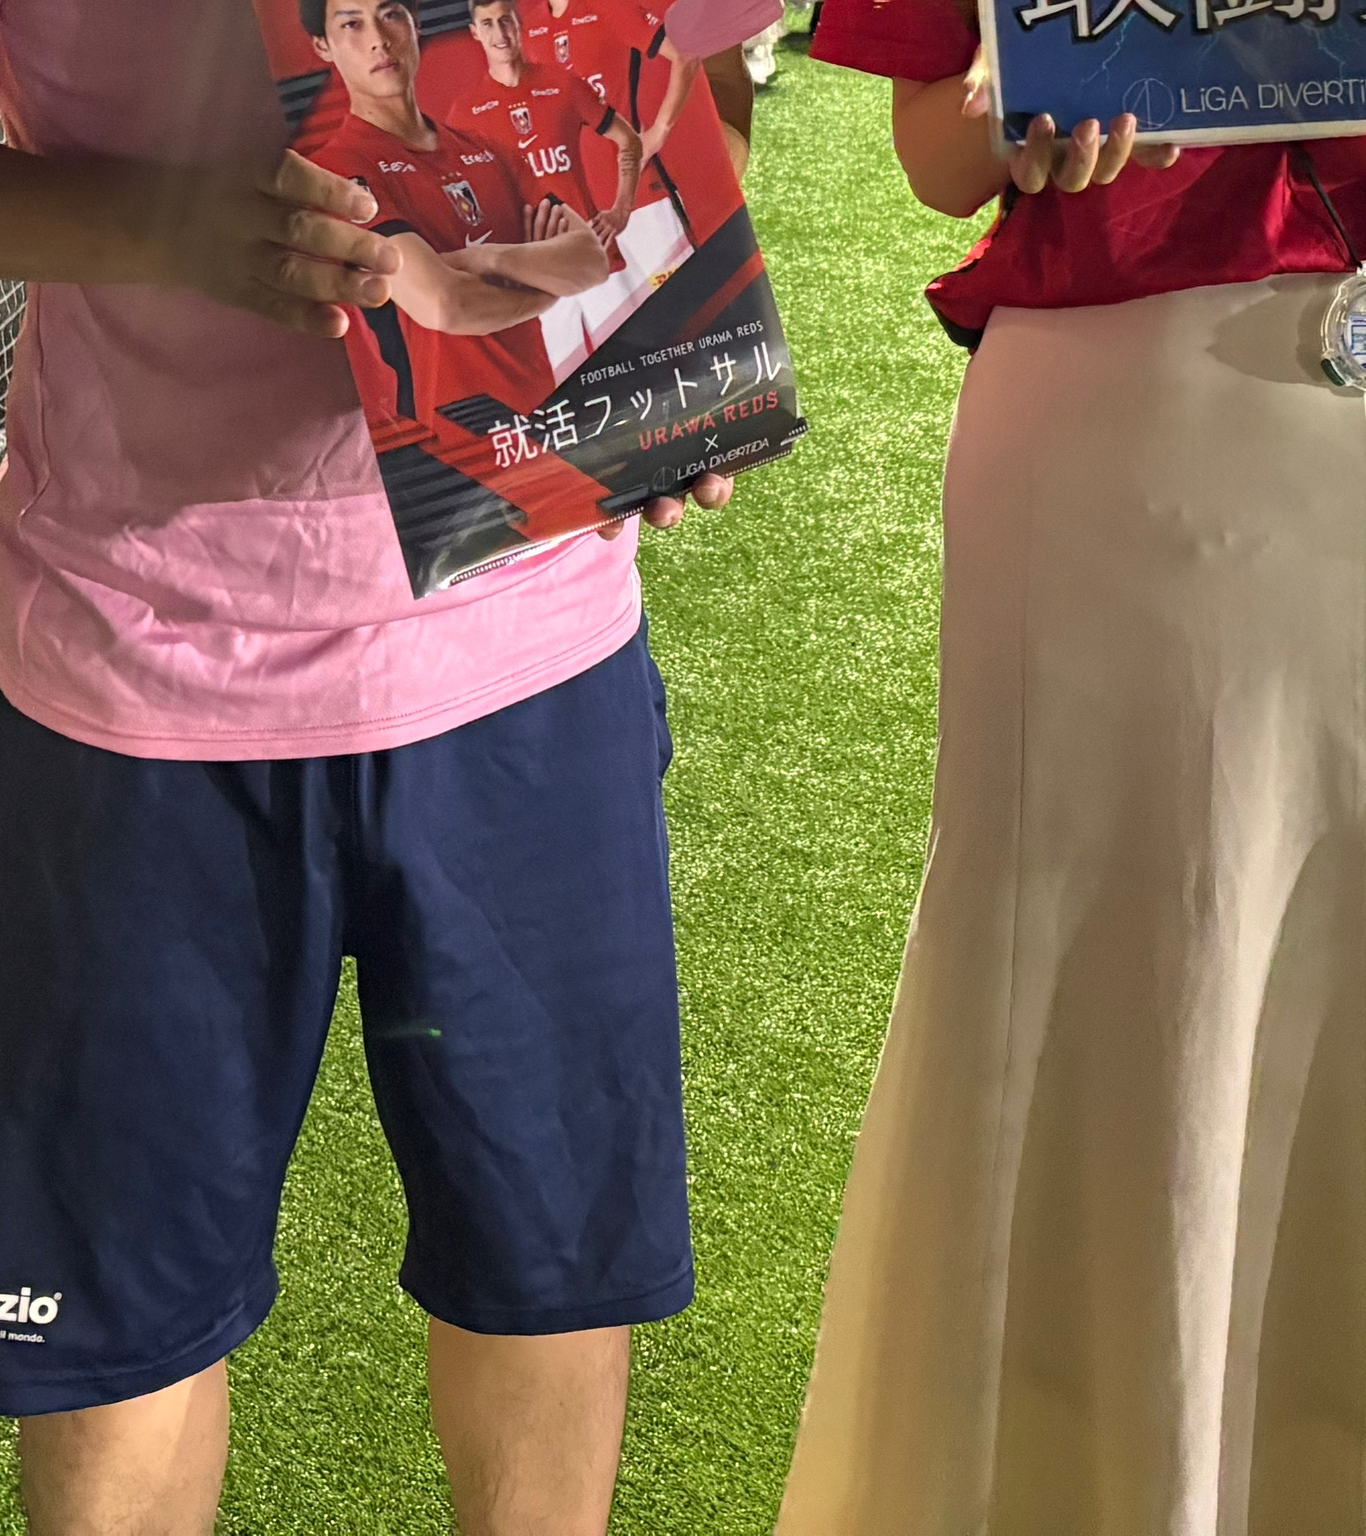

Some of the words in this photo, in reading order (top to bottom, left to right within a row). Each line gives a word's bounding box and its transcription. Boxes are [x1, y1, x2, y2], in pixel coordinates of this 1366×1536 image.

[526, 144, 571, 177] LUS
[580, 360, 636, 386] FOOTBALL
[640, 341, 695, 366] TOGETHER
[698, 332, 733, 350] URAWA
[737, 320, 764, 337] REDS
[487, 341, 782, 469] 就活フットサル
[638, 412, 716, 451] URAWA
[723, 391, 780, 424] REDS
